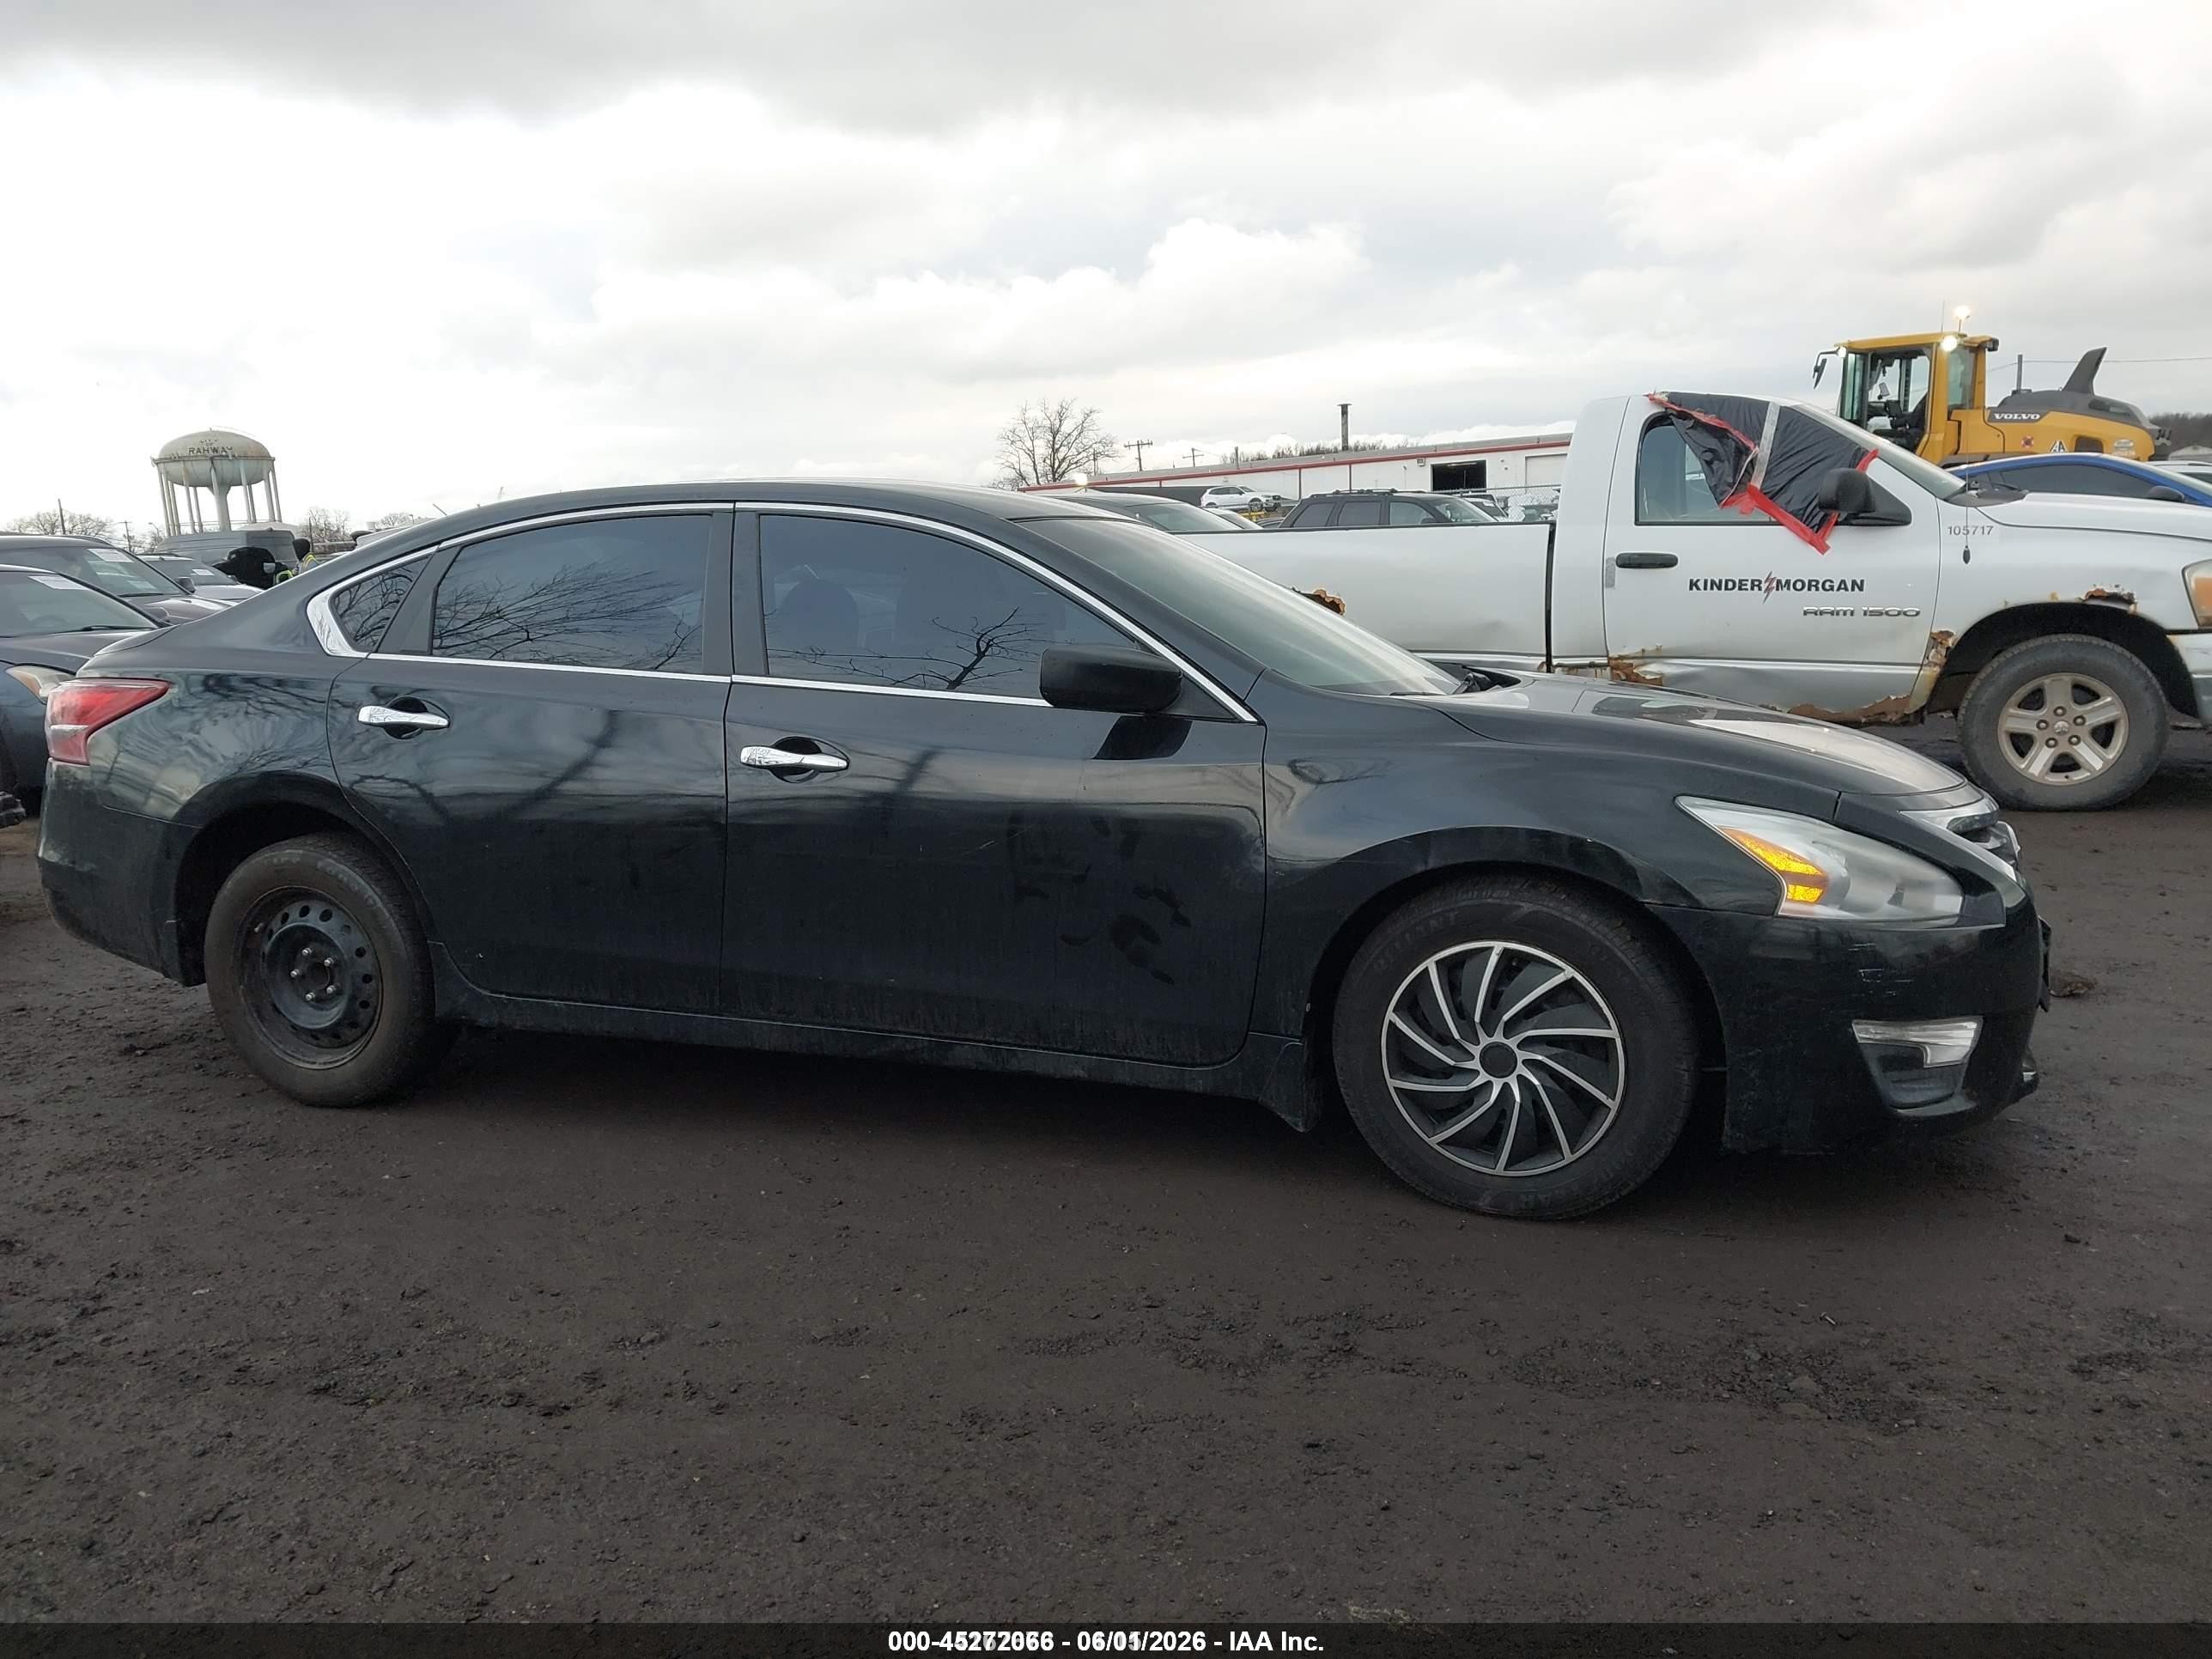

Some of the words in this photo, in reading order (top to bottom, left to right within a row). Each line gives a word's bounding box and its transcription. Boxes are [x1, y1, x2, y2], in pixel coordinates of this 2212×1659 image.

[188, 446, 234, 454] RAHWAY
[1948, 525, 1994, 536] 105717
[1688, 578, 1763, 592] KINDER
[1775, 578, 1865, 592] MORGAN
[1802, 606, 1855, 617] RAM
[1862, 606, 1921, 617] 1500
